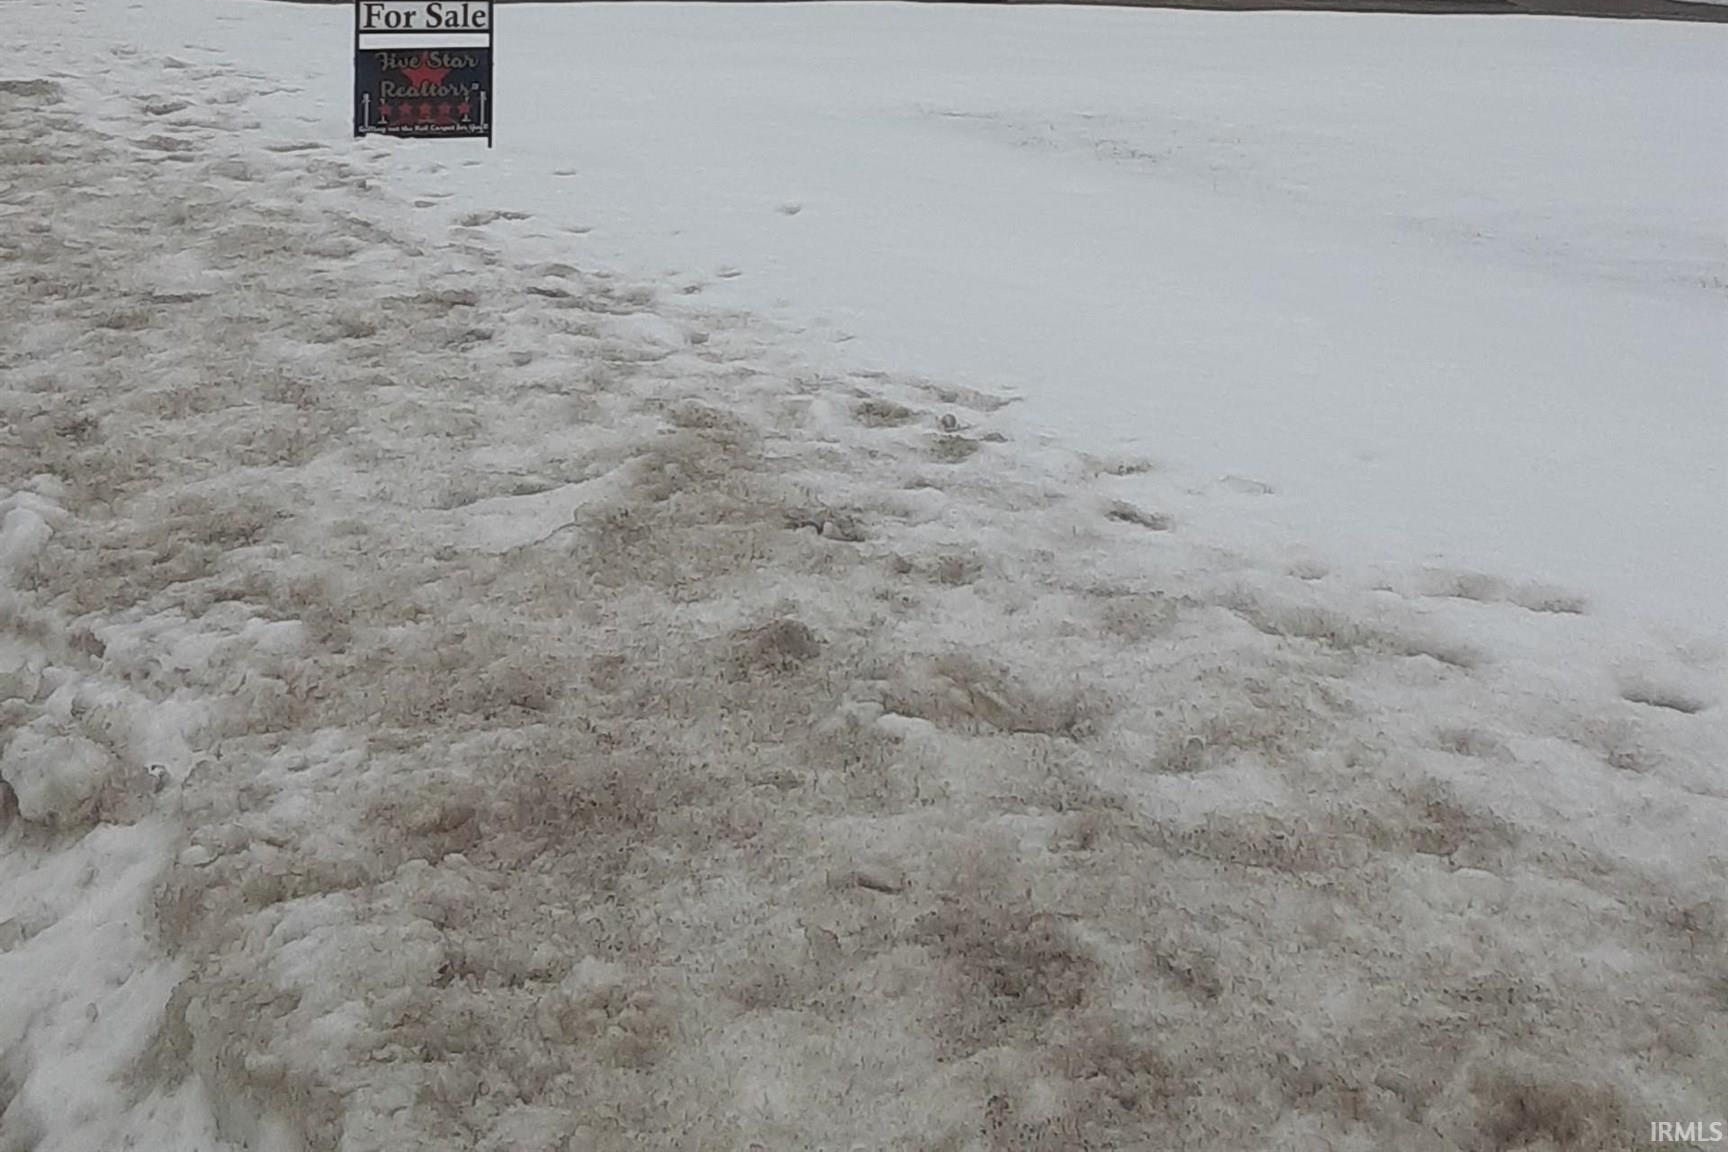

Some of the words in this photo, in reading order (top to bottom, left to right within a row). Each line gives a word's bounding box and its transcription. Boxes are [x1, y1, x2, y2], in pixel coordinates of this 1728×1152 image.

[363, 3, 416, 28] For
[426, 2, 486, 28] Sale
[375, 52, 421, 70] Five
[427, 51, 478, 68] Star
